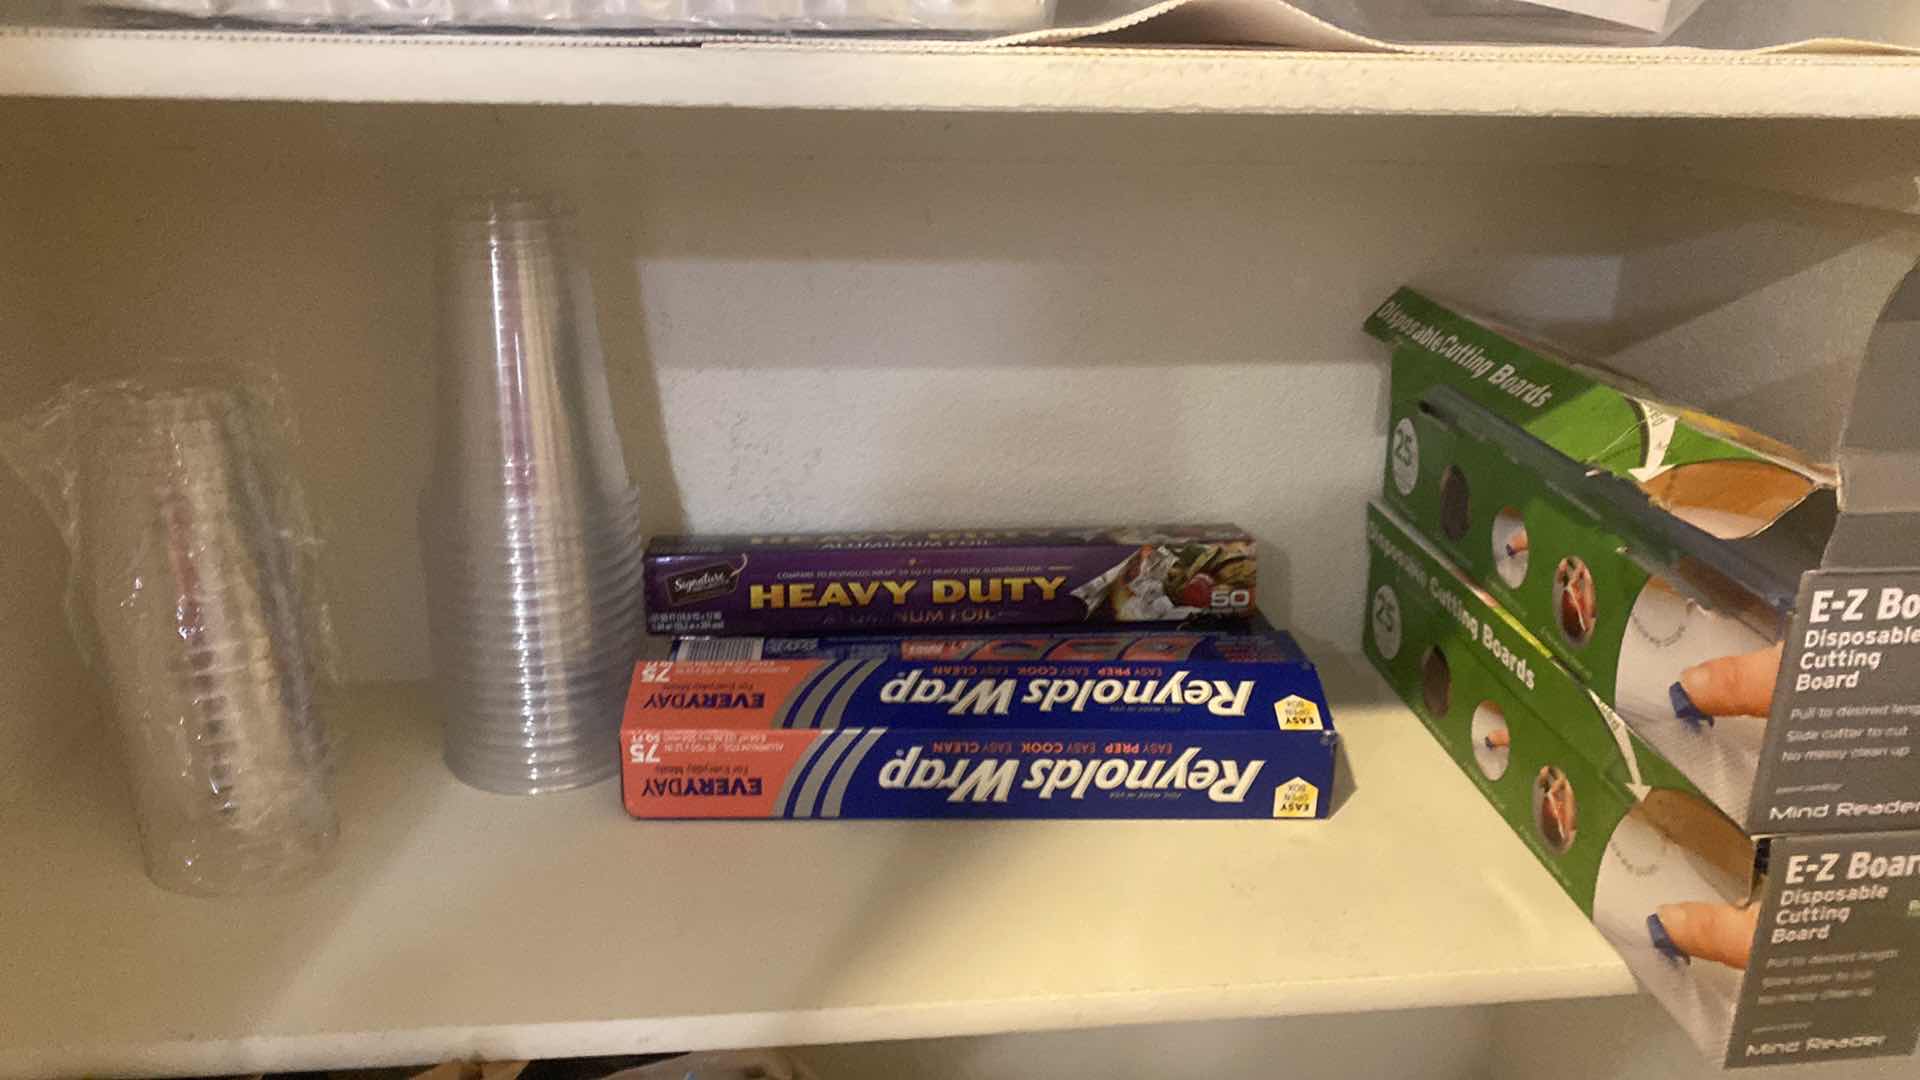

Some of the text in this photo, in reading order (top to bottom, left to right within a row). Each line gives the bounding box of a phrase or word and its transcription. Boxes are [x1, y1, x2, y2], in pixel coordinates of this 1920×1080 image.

[1375, 300, 1553, 408] Disposable Cutting Boards
[1396, 429, 1412, 467] 25
[750, 579, 917, 609] HEAVY
[931, 576, 1067, 604] DUTY
[1210, 589, 1250, 608] 50
[1808, 588, 1869, 623] E-Z
[1430, 576, 1478, 641] Cutting
[1483, 624, 1535, 690] Boards
[1803, 625, 1920, 649] Disposable
[1800, 650, 1881, 671] Cutting
[932, 666, 977, 676] CLEAN
[1017, 666, 1057, 676] COOK
[1097, 667, 1132, 677] PREP
[1795, 671, 1859, 691] Board
[643, 692, 766, 709] EVERYDAY
[1021, 671, 1255, 716] Reynolds
[1284, 716, 1314, 725] EASY
[1822, 727, 1864, 739] cutter
[1884, 725, 1909, 737] cut
[629, 743, 661, 764] 75
[932, 742, 980, 753] CLEAN
[1021, 742, 1064, 753] COOK
[1104, 742, 1139, 753] PREP
[1021, 746, 1267, 803] Reynolds
[641, 777, 762, 797] EVERYDAY
[1280, 802, 1310, 812] EASY
[1769, 803, 1830, 821] Mind
[1785, 850, 1920, 884] E-Z Boar
[1780, 884, 1889, 908] Disposable
[1776, 906, 1851, 926] Cutting
[1771, 924, 1831, 944] Board
